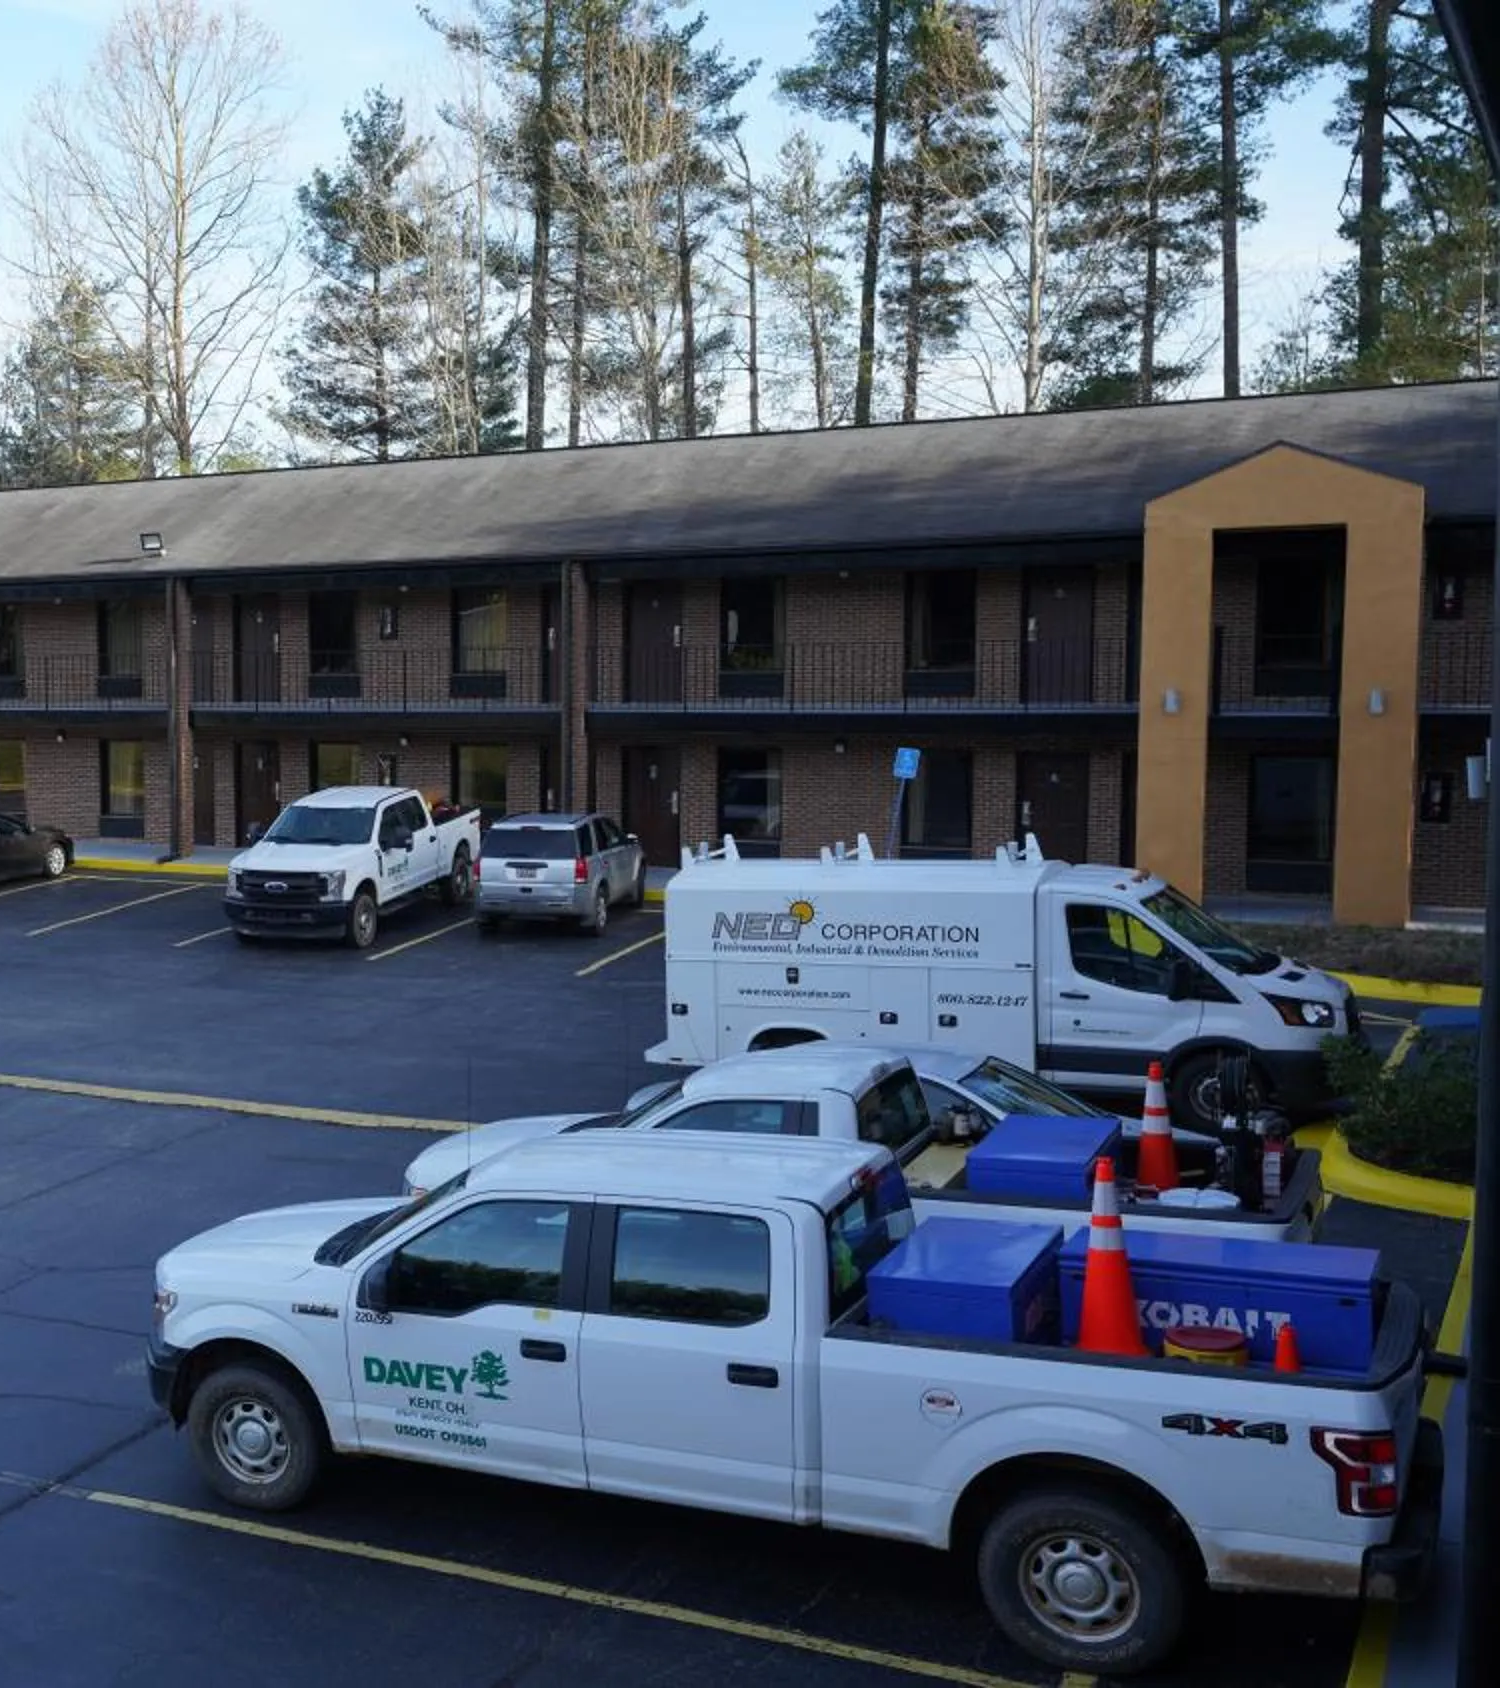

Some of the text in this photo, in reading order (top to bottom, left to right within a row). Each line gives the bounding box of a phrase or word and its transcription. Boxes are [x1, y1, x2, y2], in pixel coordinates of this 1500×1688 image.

[711, 912, 980, 943] NEO CORPORATION
[932, 946, 980, 959] Services
[363, 1356, 468, 1394] DAVEY
[395, 1423, 437, 1440] USDOT
